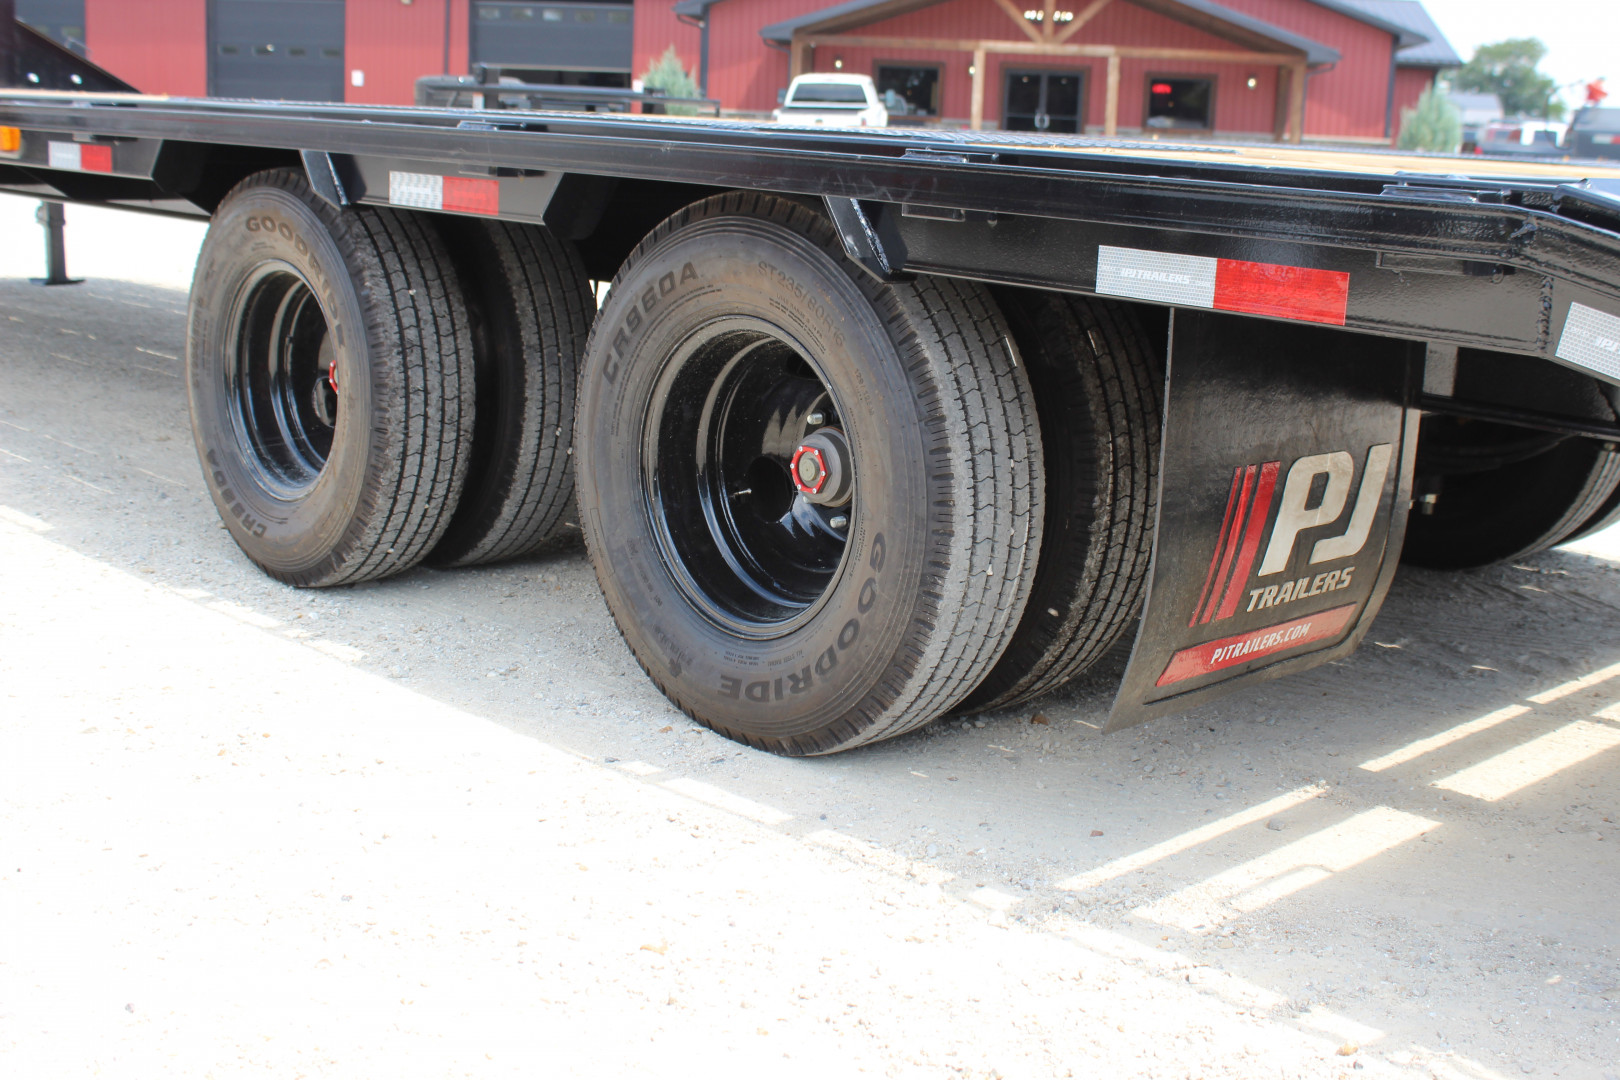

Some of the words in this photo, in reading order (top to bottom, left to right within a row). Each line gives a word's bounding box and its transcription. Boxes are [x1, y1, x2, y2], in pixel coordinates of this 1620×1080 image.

[602, 262, 699, 385] CR960A
[758, 261, 846, 347] ST235/80R16
[1258, 443, 1393, 577] PJ
[720, 532, 887, 703] GOODRIDE
[1247, 567, 1355, 612] TRAILERS
[1210, 623, 1312, 664] PJTRAILERS.COM
